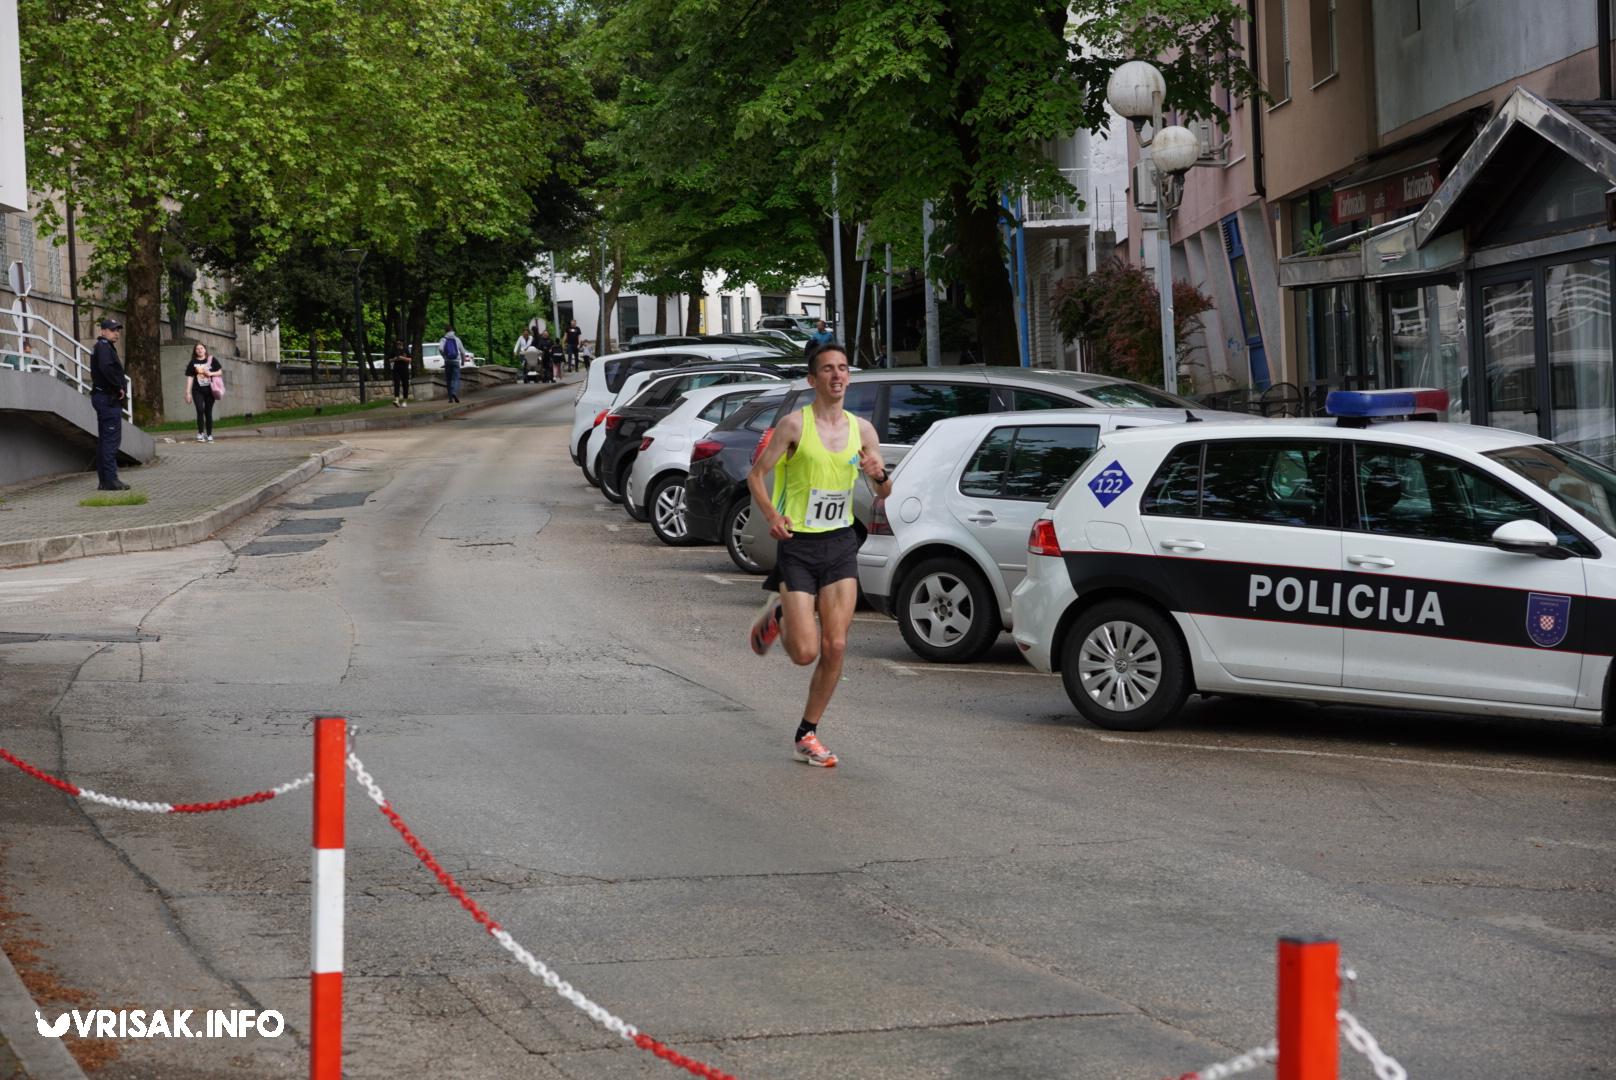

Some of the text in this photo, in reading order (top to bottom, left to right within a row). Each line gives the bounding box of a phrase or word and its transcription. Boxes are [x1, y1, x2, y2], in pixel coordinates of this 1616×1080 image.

[1095, 478, 1123, 493] 122
[814, 501, 845, 520] 101
[1248, 574, 1445, 626] POLICIJA
